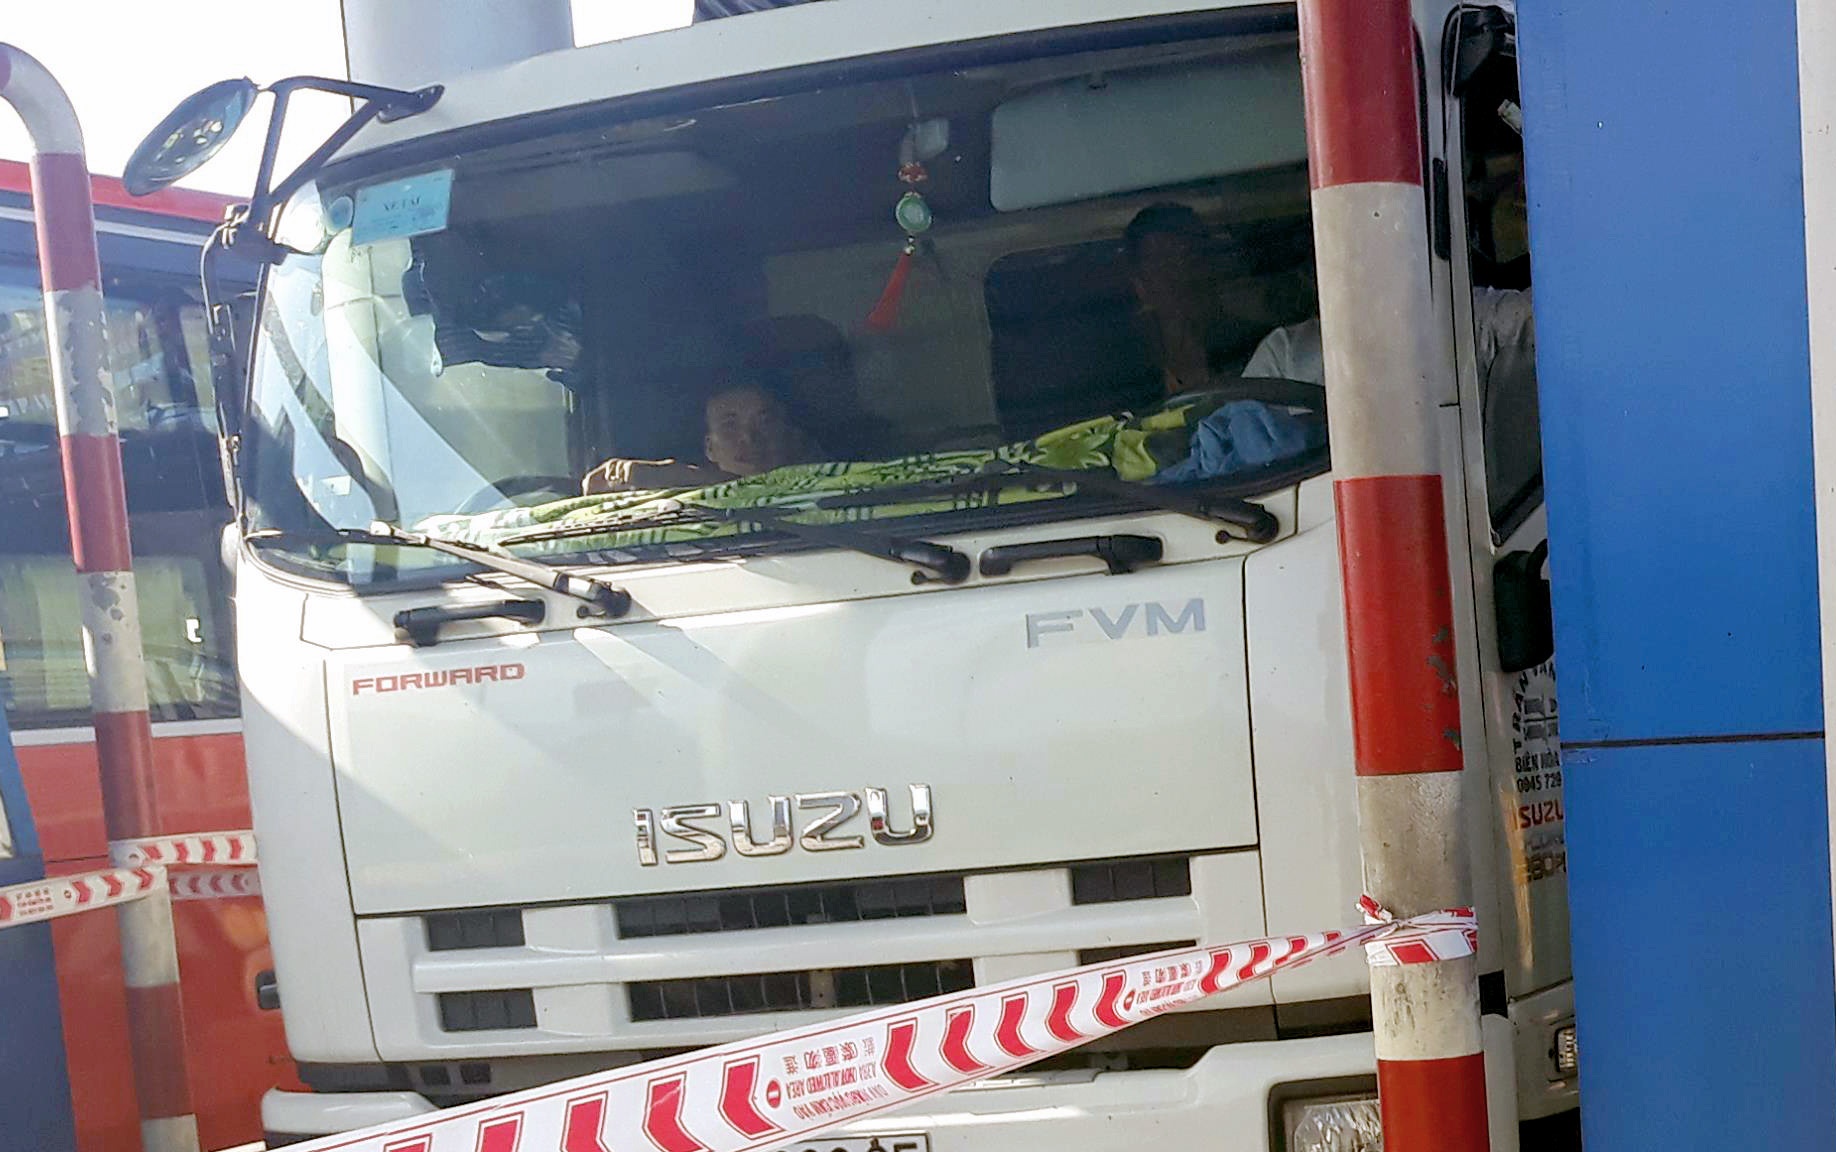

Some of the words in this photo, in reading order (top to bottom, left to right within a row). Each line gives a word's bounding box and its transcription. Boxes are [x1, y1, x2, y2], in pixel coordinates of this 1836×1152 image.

[1026, 598, 1207, 649] FVM
[351, 662, 526, 697] FORWARD
[632, 784, 934, 867] ISUZU
